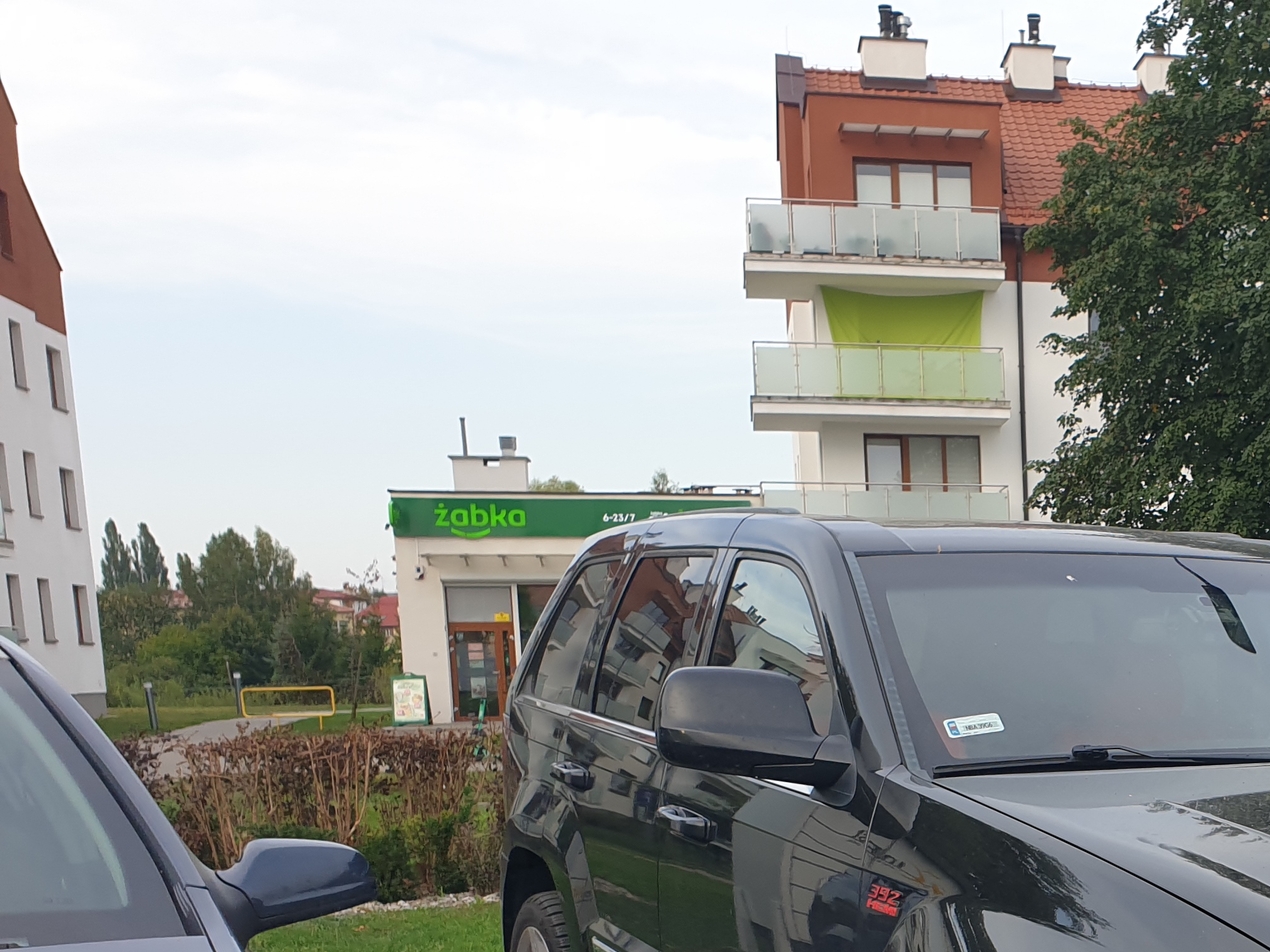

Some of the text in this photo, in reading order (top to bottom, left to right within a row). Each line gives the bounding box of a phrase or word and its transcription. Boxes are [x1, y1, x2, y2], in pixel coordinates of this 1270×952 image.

[434, 502, 527, 528] żabka
[602, 512, 636, 523] 6-23/7
[867, 883, 903, 907] 392
[866, 898, 899, 918] HEMI
